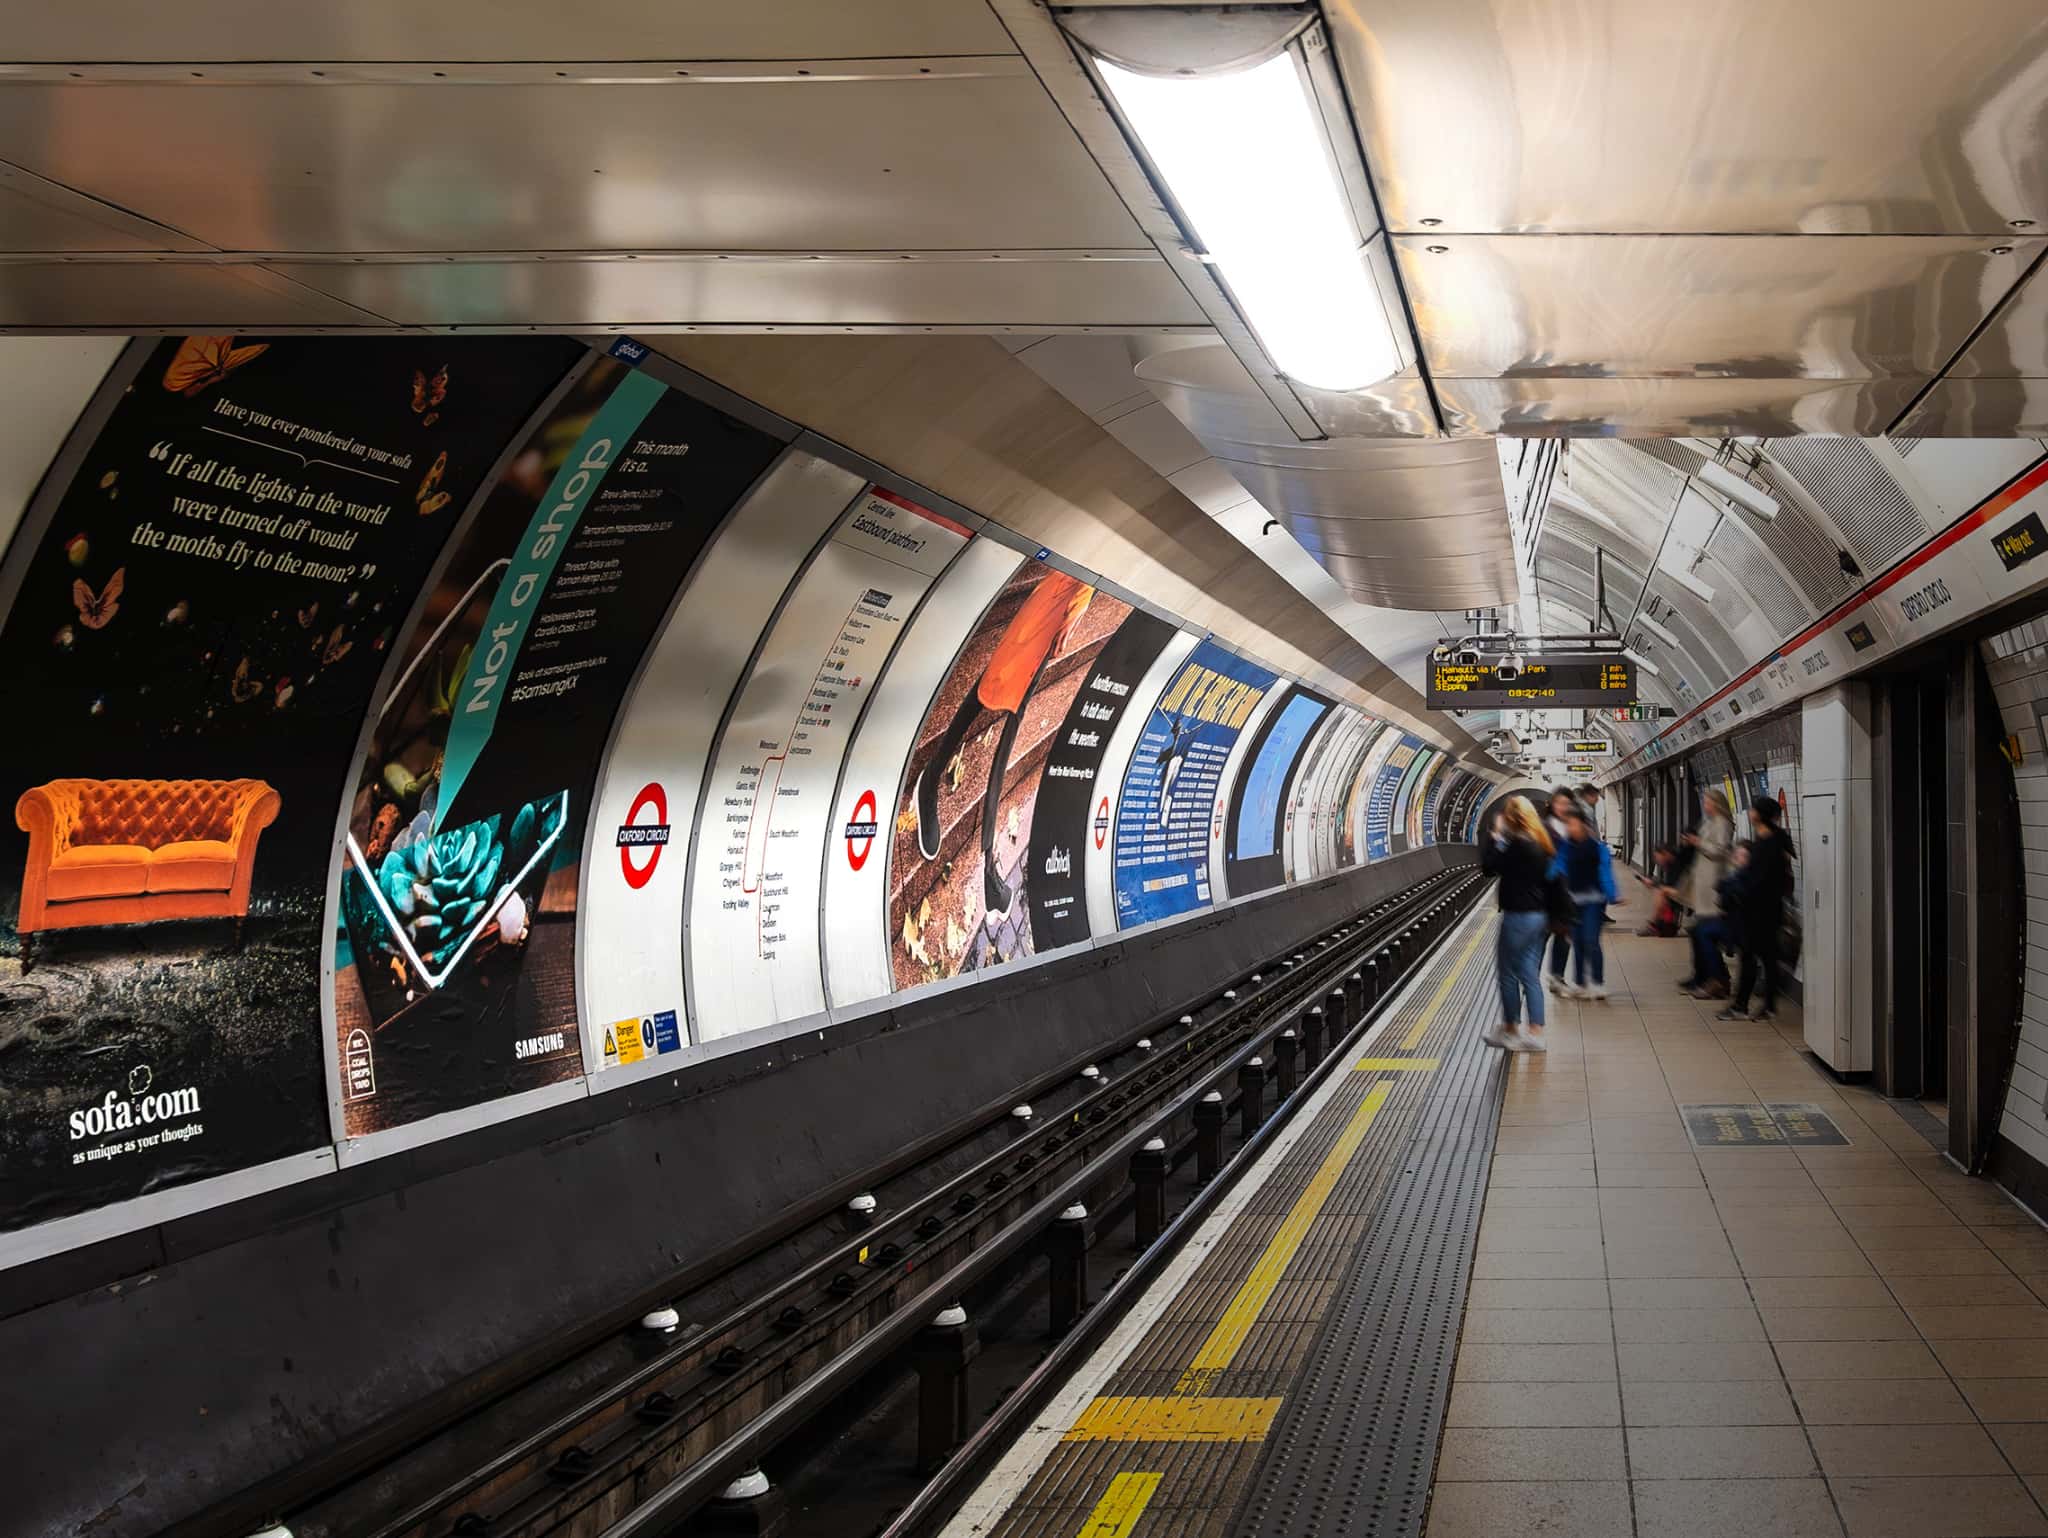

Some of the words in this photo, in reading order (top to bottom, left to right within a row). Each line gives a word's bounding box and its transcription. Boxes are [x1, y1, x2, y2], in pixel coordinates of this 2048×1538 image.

[214, 398, 247, 421] Have
[248, 412, 272, 429] you
[272, 416, 299, 435] ever
[298, 425, 352, 452] pondered
[350, 440, 367, 456] on
[365, 446, 392, 465] your
[389, 449, 412, 470] sofa
[632, 440, 656, 455] This
[654, 442, 690, 456] month
[186, 457, 214, 483] all
[214, 463, 247, 492] the
[245, 472, 296, 504] lights
[296, 484, 318, 508] in
[314, 489, 343, 516] the
[343, 500, 391, 527] world
[171, 495, 218, 521] were
[219, 504, 280, 536] turned
[279, 515, 310, 540] off
[309, 523, 358, 552] would
[851, 514, 891, 541] Eastbound
[130, 521, 164, 547] the
[165, 531, 225, 560] moths
[225, 540, 254, 571] fly
[253, 547, 274, 569] to
[273, 551, 302, 578] the
[2008, 535, 2025, 555] Way
[2021, 529, 2035, 547] out
[465, 619, 519, 714] Not
[510, 571, 540, 608] a
[530, 437, 612, 563] shop
[1900, 591, 1930, 622] OXFORD
[1922, 577, 1952, 610] CIRCUS
[1441, 665, 1475, 674] Hainault
[1476, 666, 1489, 674] via
[1527, 664, 1547, 674] Park
[1441, 672, 1480, 683] Loughton
[1609, 672, 1628, 681] mins
[1441, 682, 1468, 692] Epping
[1609, 681, 1628, 689] mins
[619, 830, 645, 842] OXFORD
[645, 829, 668, 841] CIRCUS
[514, 1031, 565, 1060] SAMSUNG
[351, 1057, 368, 1068] COAL
[69, 1086, 201, 1140] sofa.com
[72, 1152, 85, 1165] as
[87, 1143, 122, 1161] unique
[124, 1139, 136, 1152] as
[137, 1133, 160, 1153] your
[161, 1124, 203, 1143] thoughts
